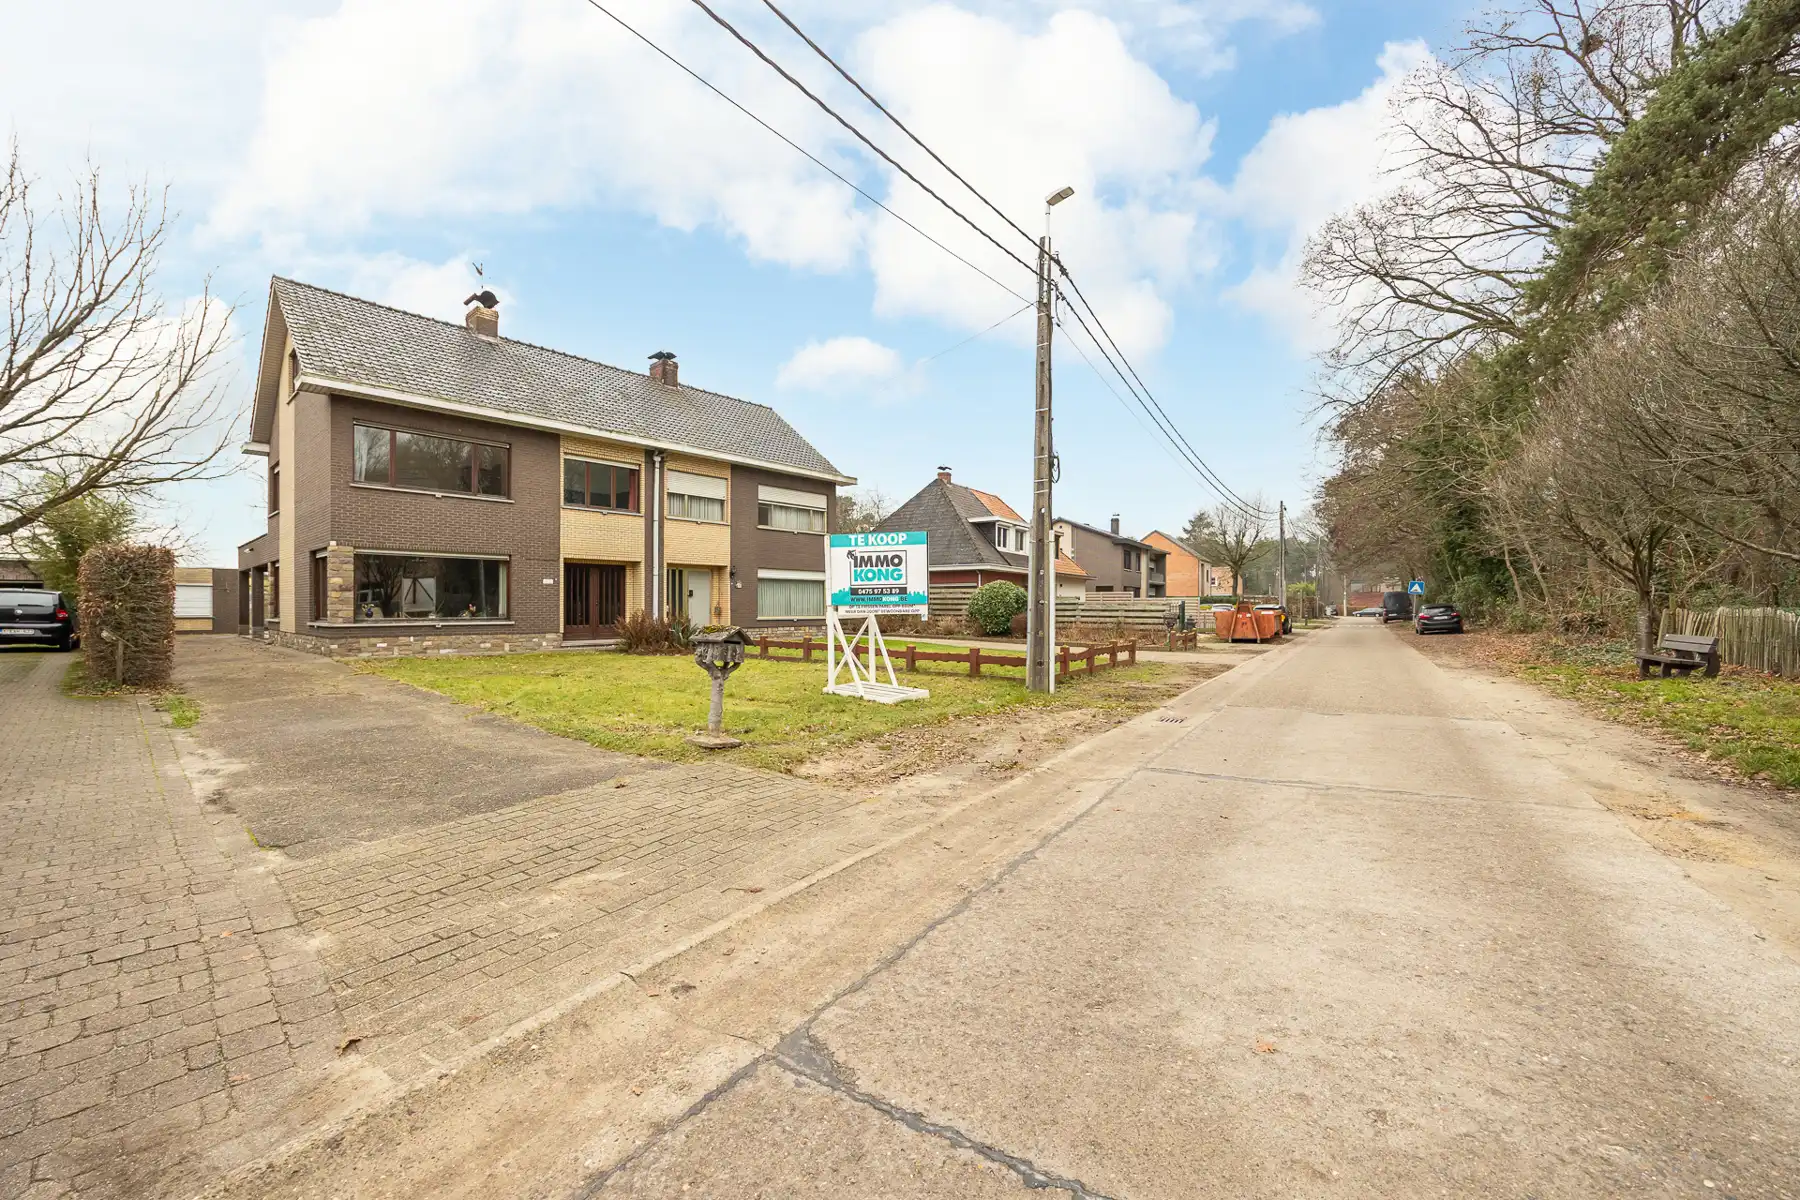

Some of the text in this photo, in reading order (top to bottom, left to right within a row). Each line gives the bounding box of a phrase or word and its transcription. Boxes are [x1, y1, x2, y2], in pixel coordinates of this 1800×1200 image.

[848, 533, 907, 546] TE KOOP
[853, 554, 903, 568] IMMO
[853, 568, 903, 582] KONG
